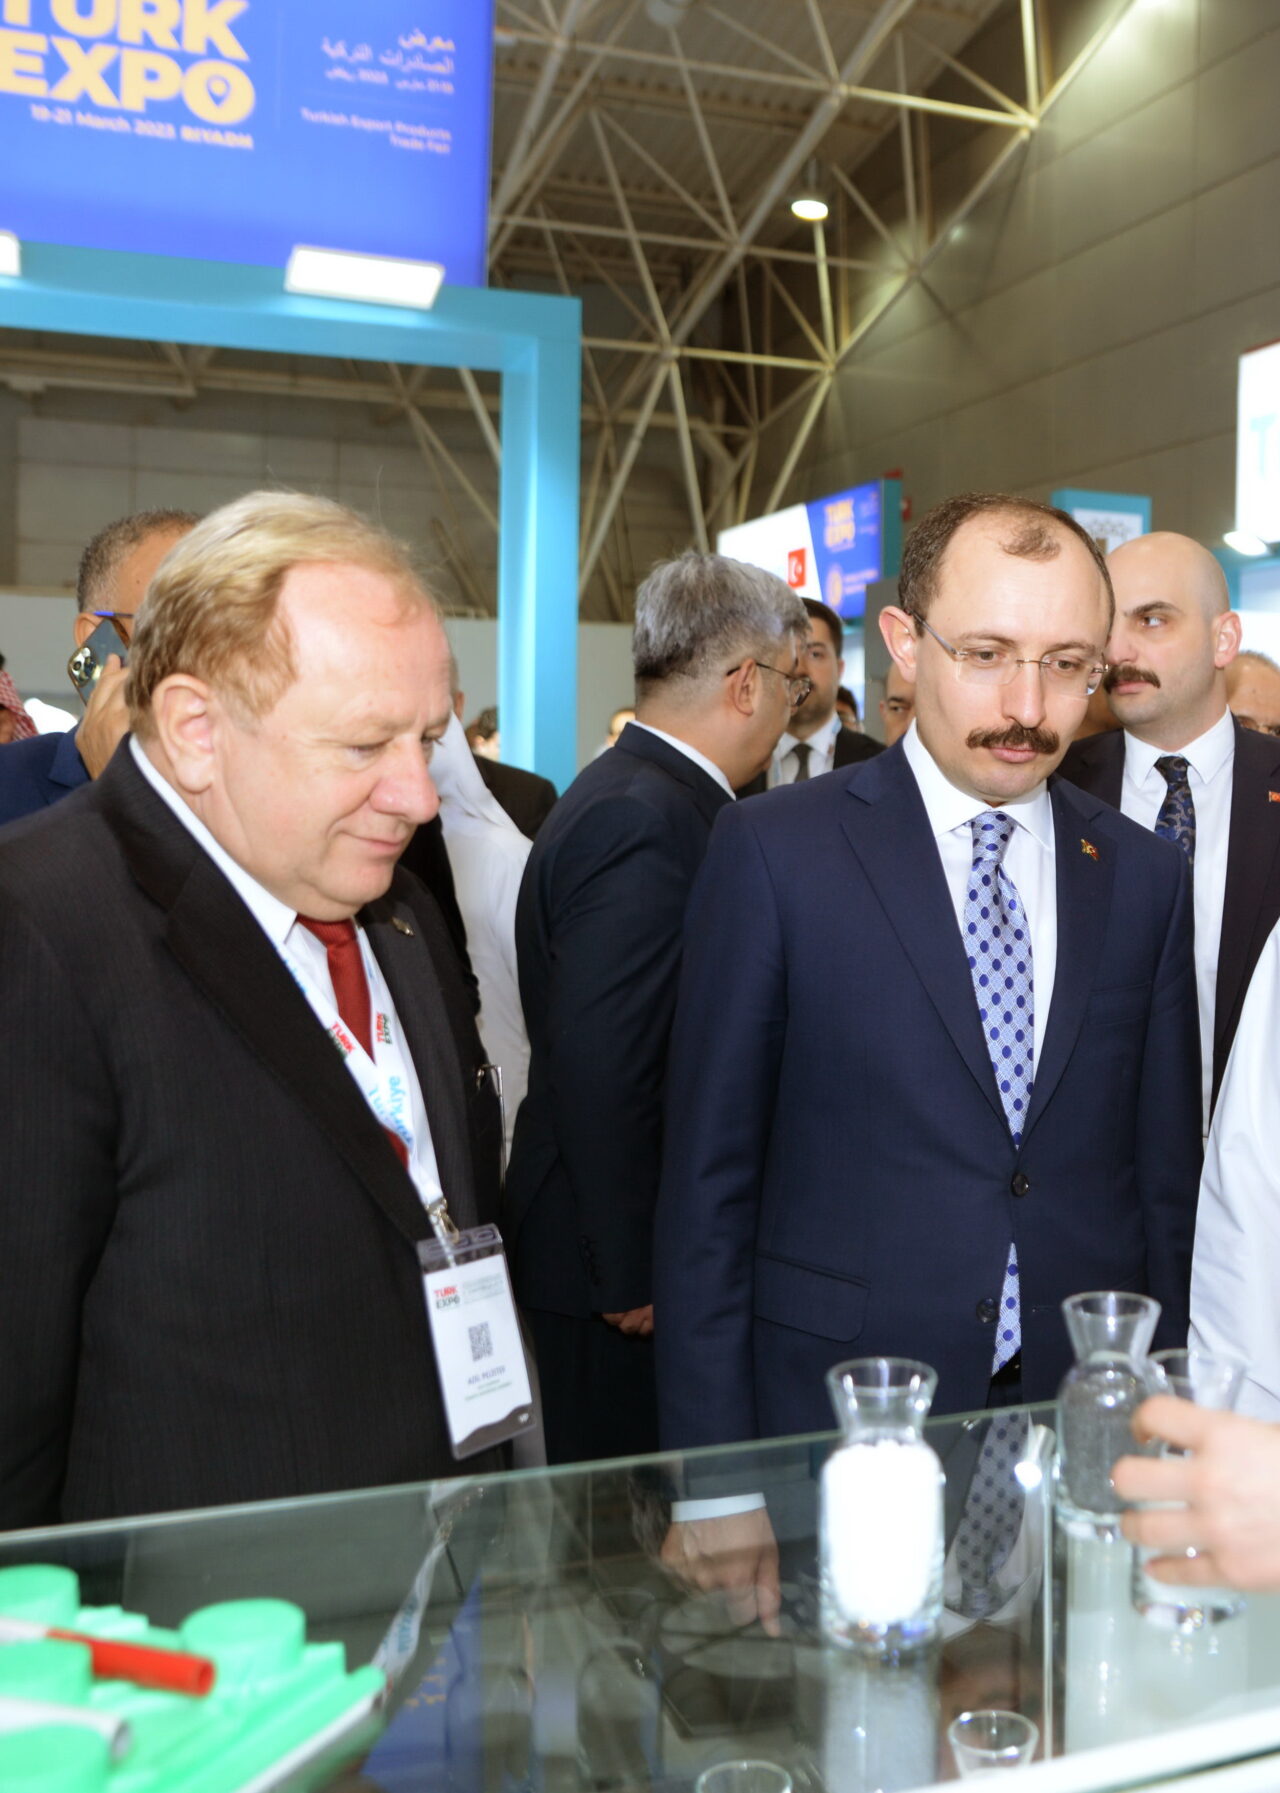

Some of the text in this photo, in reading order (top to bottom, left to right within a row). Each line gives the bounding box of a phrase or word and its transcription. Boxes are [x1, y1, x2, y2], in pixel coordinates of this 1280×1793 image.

[0, 27, 255, 125] EXPO
[331, 1021, 356, 1055] TURK
[433, 1286, 458, 1298] TURK
